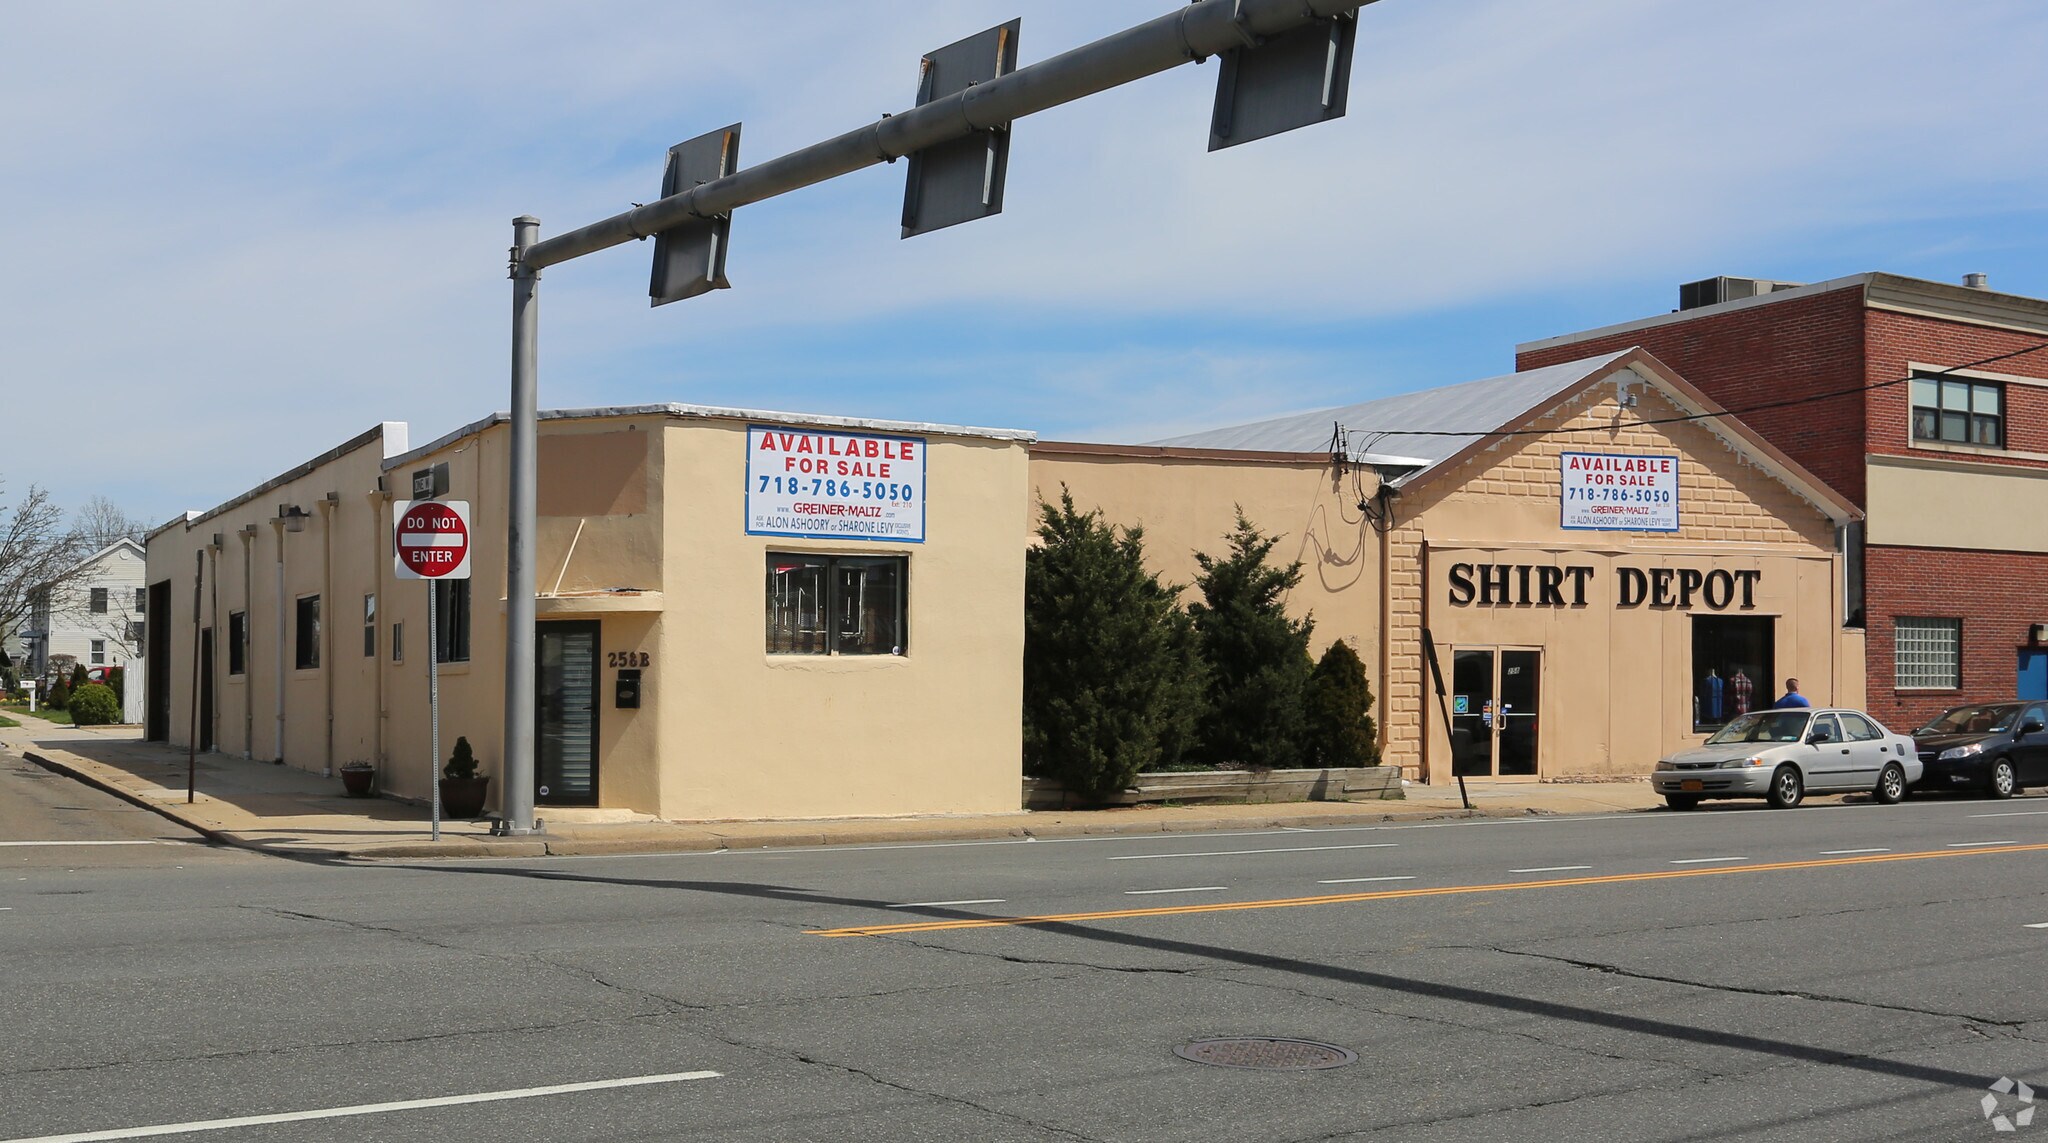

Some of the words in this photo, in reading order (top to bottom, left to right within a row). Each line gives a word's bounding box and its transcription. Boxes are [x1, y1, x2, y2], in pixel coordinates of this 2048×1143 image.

[760, 432, 914, 460] AVAILABLE
[785, 457, 829, 474] FOR
[837, 460, 891, 478] SALE
[1569, 457, 1670, 473] AVAILABLE
[759, 475, 913, 501] 718-786-5050
[1586, 474, 1614, 485] FOR
[1619, 474, 1655, 486] SALE
[1569, 487, 1669, 502] 718-786-5050
[793, 502, 882, 518] GREINER-MALTZ
[1591, 505, 1649, 515] GREINER-MALTZ
[407, 517, 425, 529] DO
[432, 517, 457, 529] NOT
[766, 516, 789, 529] ALON
[790, 517, 830, 531] ASHOORY
[839, 519, 875, 533] SHARONE
[876, 521, 895, 534] LEVY
[412, 550, 453, 563] ENTER
[1448, 562, 1595, 607] SHIRT
[1616, 567, 1761, 609] DEPOT
[607, 651, 650, 668] 258B
